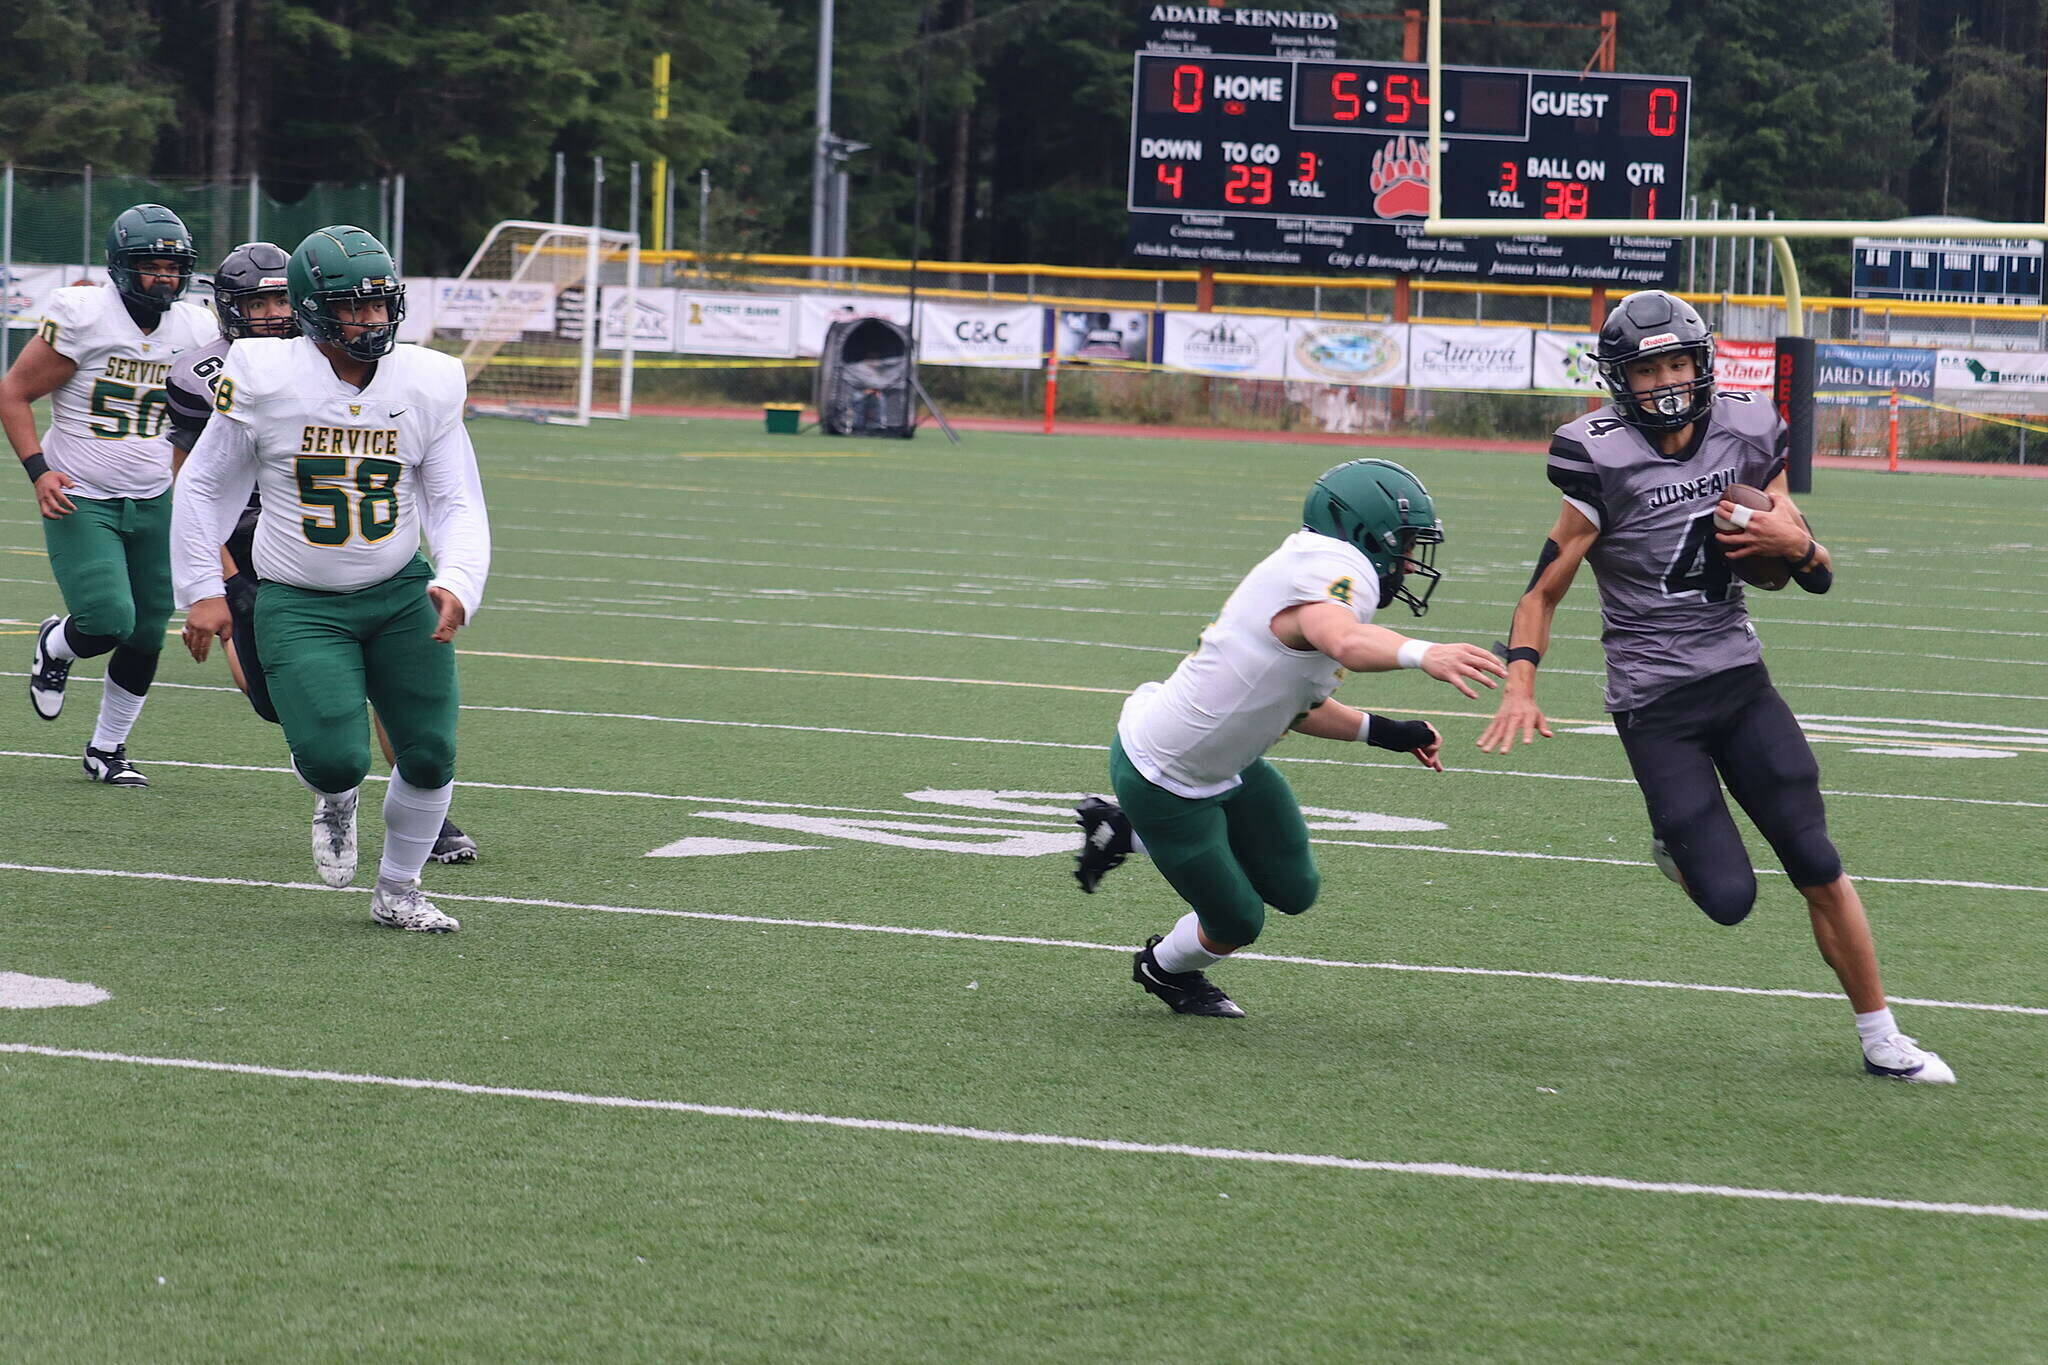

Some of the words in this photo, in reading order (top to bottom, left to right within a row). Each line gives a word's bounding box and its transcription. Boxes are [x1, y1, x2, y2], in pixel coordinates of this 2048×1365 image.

[1172, 65, 1204, 114] 0
[1213, 75, 1284, 102] HOME
[1531, 91, 1609, 118] GUEST
[1648, 88, 1678, 137] 0
[1140, 138, 1202, 160] DOWN
[1221, 142, 1247, 163] TO
[1250, 144, 1281, 165] GO
[1298, 151, 1317, 182] 3
[1500, 161, 1518, 192] 3
[1527, 157, 1572, 180] BALL
[1576, 160, 1606, 182] ON
[1626, 162, 1665, 186] QTR
[1157, 164, 1184, 199] 4
[1224, 164, 1273, 205] 23
[1544, 181, 1588, 220] 38
[1170, 225, 1235, 240] Construction
[1283, 232, 1303, 244] and
[1243, 248, 1301, 263] Association
[1495, 241, 1529, 255] Vision
[1529, 243, 1563, 257] Center
[1613, 247, 1666, 262] Restaurant
[1328, 252, 1353, 268] City
[1355, 254, 1366, 266] &
[1367, 255, 1419, 272] Borough
[1420, 257, 1436, 273] of
[1433, 258, 1479, 273] Juneau
[1488, 260, 1535, 276] Juneau
[1536, 262, 1570, 277] Youth
[1572, 264, 1620, 280] Football
[1621, 267, 1664, 284] League
[955, 321, 1009, 343] C&C
[1643, 336, 1674, 347] Riddell
[1423, 340, 1517, 366] Aurora
[105, 356, 172, 385] SERVIC
[1819, 365, 1864, 387] JARED
[1899, 369, 1931, 388] DDS
[2001, 373, 2048, 385] RECYCLIN
[1585, 416, 1626, 439] 4
[301, 425, 400, 456] SERVICE
[1648, 466, 1738, 510] JUNEAU
[295, 456, 403, 547] 58
[1660, 506, 1736, 604] 4
[1327, 576, 1354, 604] 4
